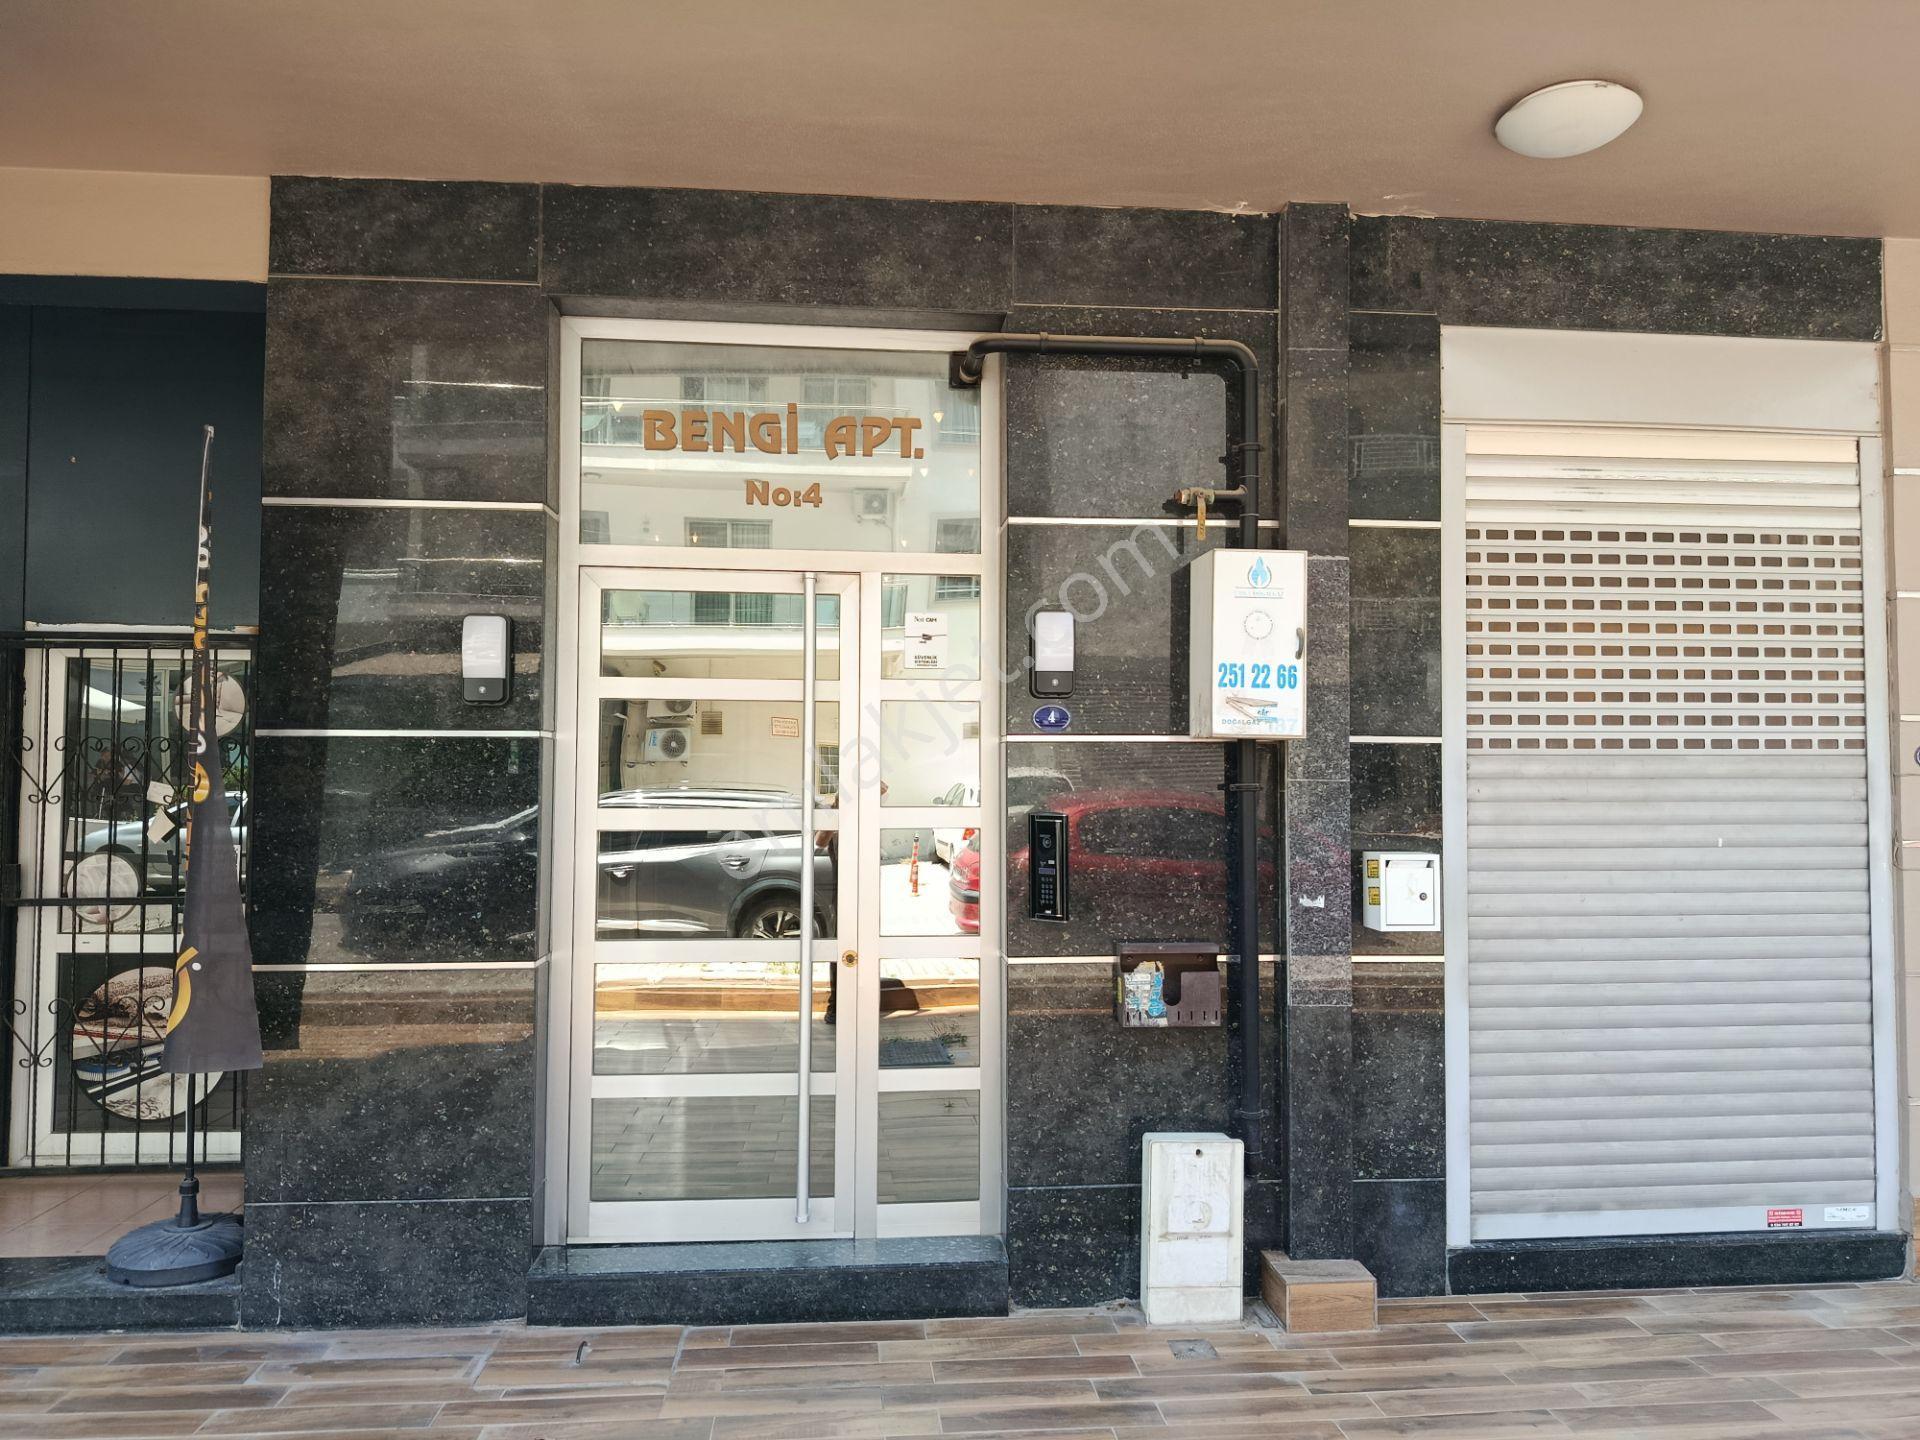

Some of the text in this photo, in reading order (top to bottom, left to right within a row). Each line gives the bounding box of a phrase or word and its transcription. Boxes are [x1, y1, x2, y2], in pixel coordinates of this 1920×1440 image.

[642, 402, 924, 460] BENGİ APT.
[745, 479, 822, 508] No:4
[1217, 662, 1298, 690] 251 22 66
[1047, 709, 1056, 724] 4
